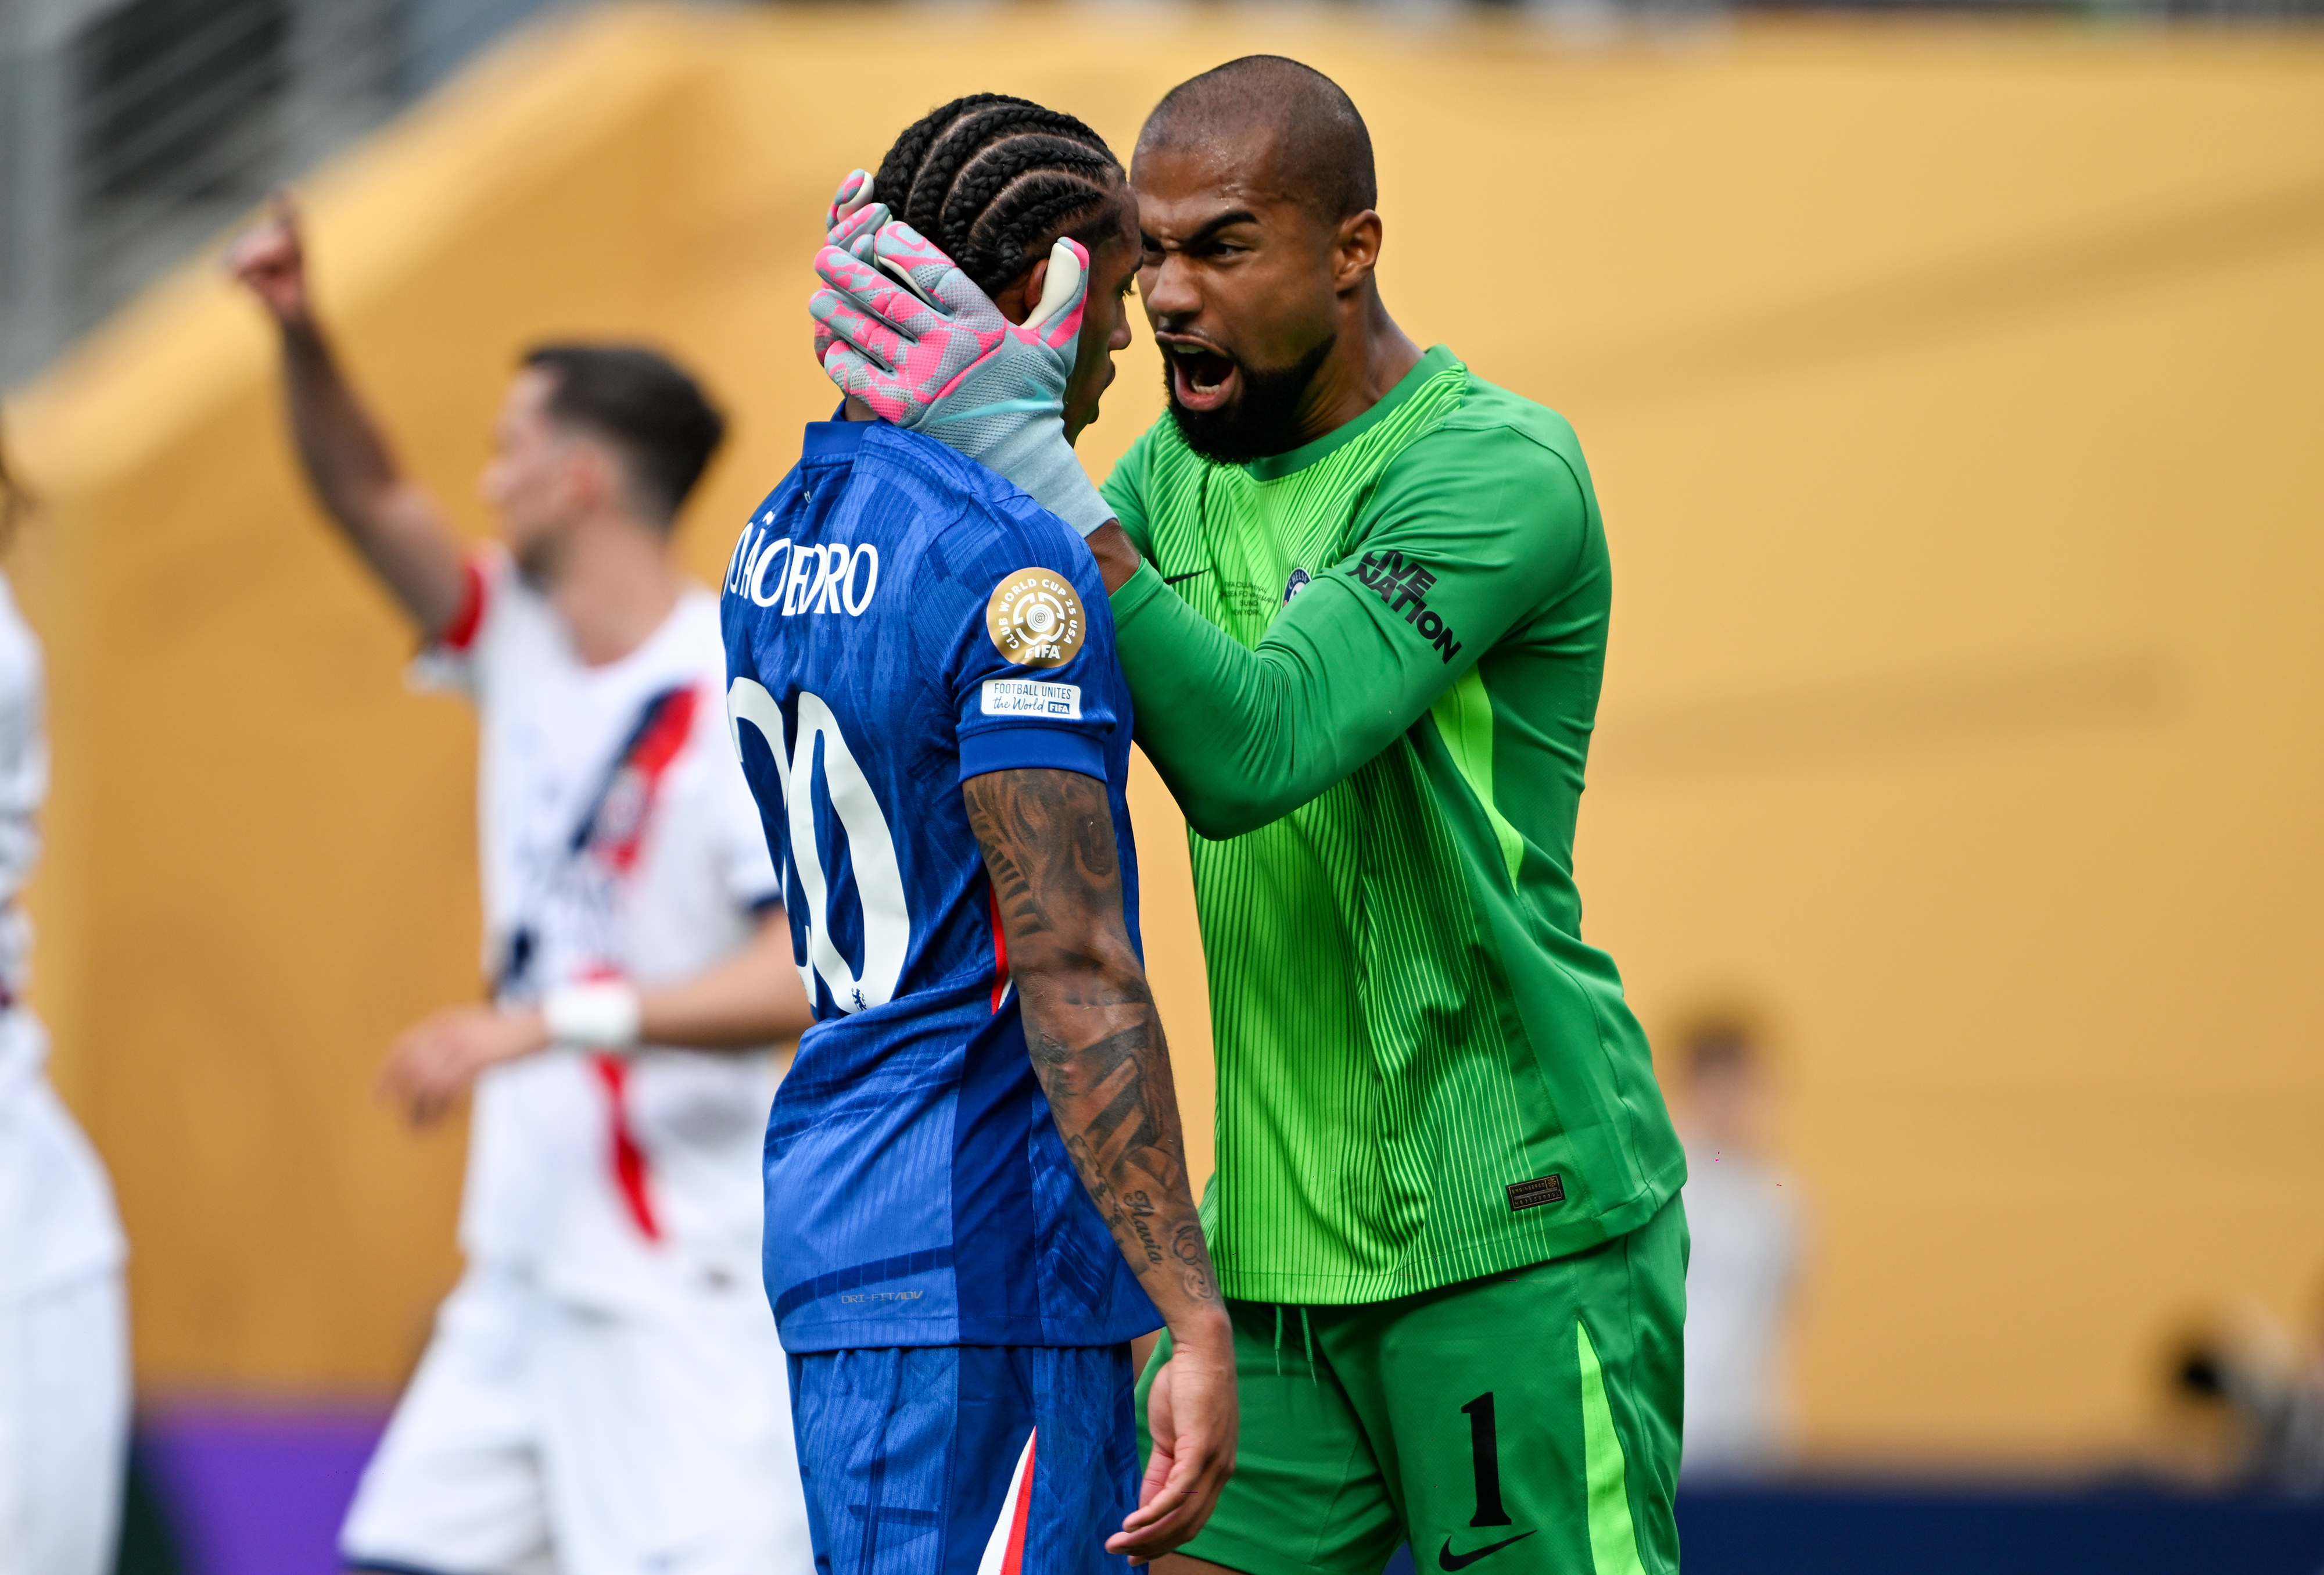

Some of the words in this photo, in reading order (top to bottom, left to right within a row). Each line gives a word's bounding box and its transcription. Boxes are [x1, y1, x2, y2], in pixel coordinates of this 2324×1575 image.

[781, 543, 878, 617] EDRO
[1042, 579, 1066, 596] CUP
[1288, 571, 1308, 590] CHELSE
[1361, 550, 1437, 600] LIVE
[999, 578, 1037, 612] WORLD
[1065, 599, 1077, 615] 25
[1345, 561, 1462, 664] NATION
[998, 617, 1020, 649] CLUB
[1057, 620, 1078, 645] USA
[1024, 645, 1061, 659] FIFA
[994, 683, 1038, 696] FOOTBALL
[1042, 686, 1071, 700] UNITES
[992, 696, 1010, 710] the
[1012, 697, 1045, 713] World
[1049, 703, 1068, 713] FIFA
[1461, 1391, 1512, 1527] 1
